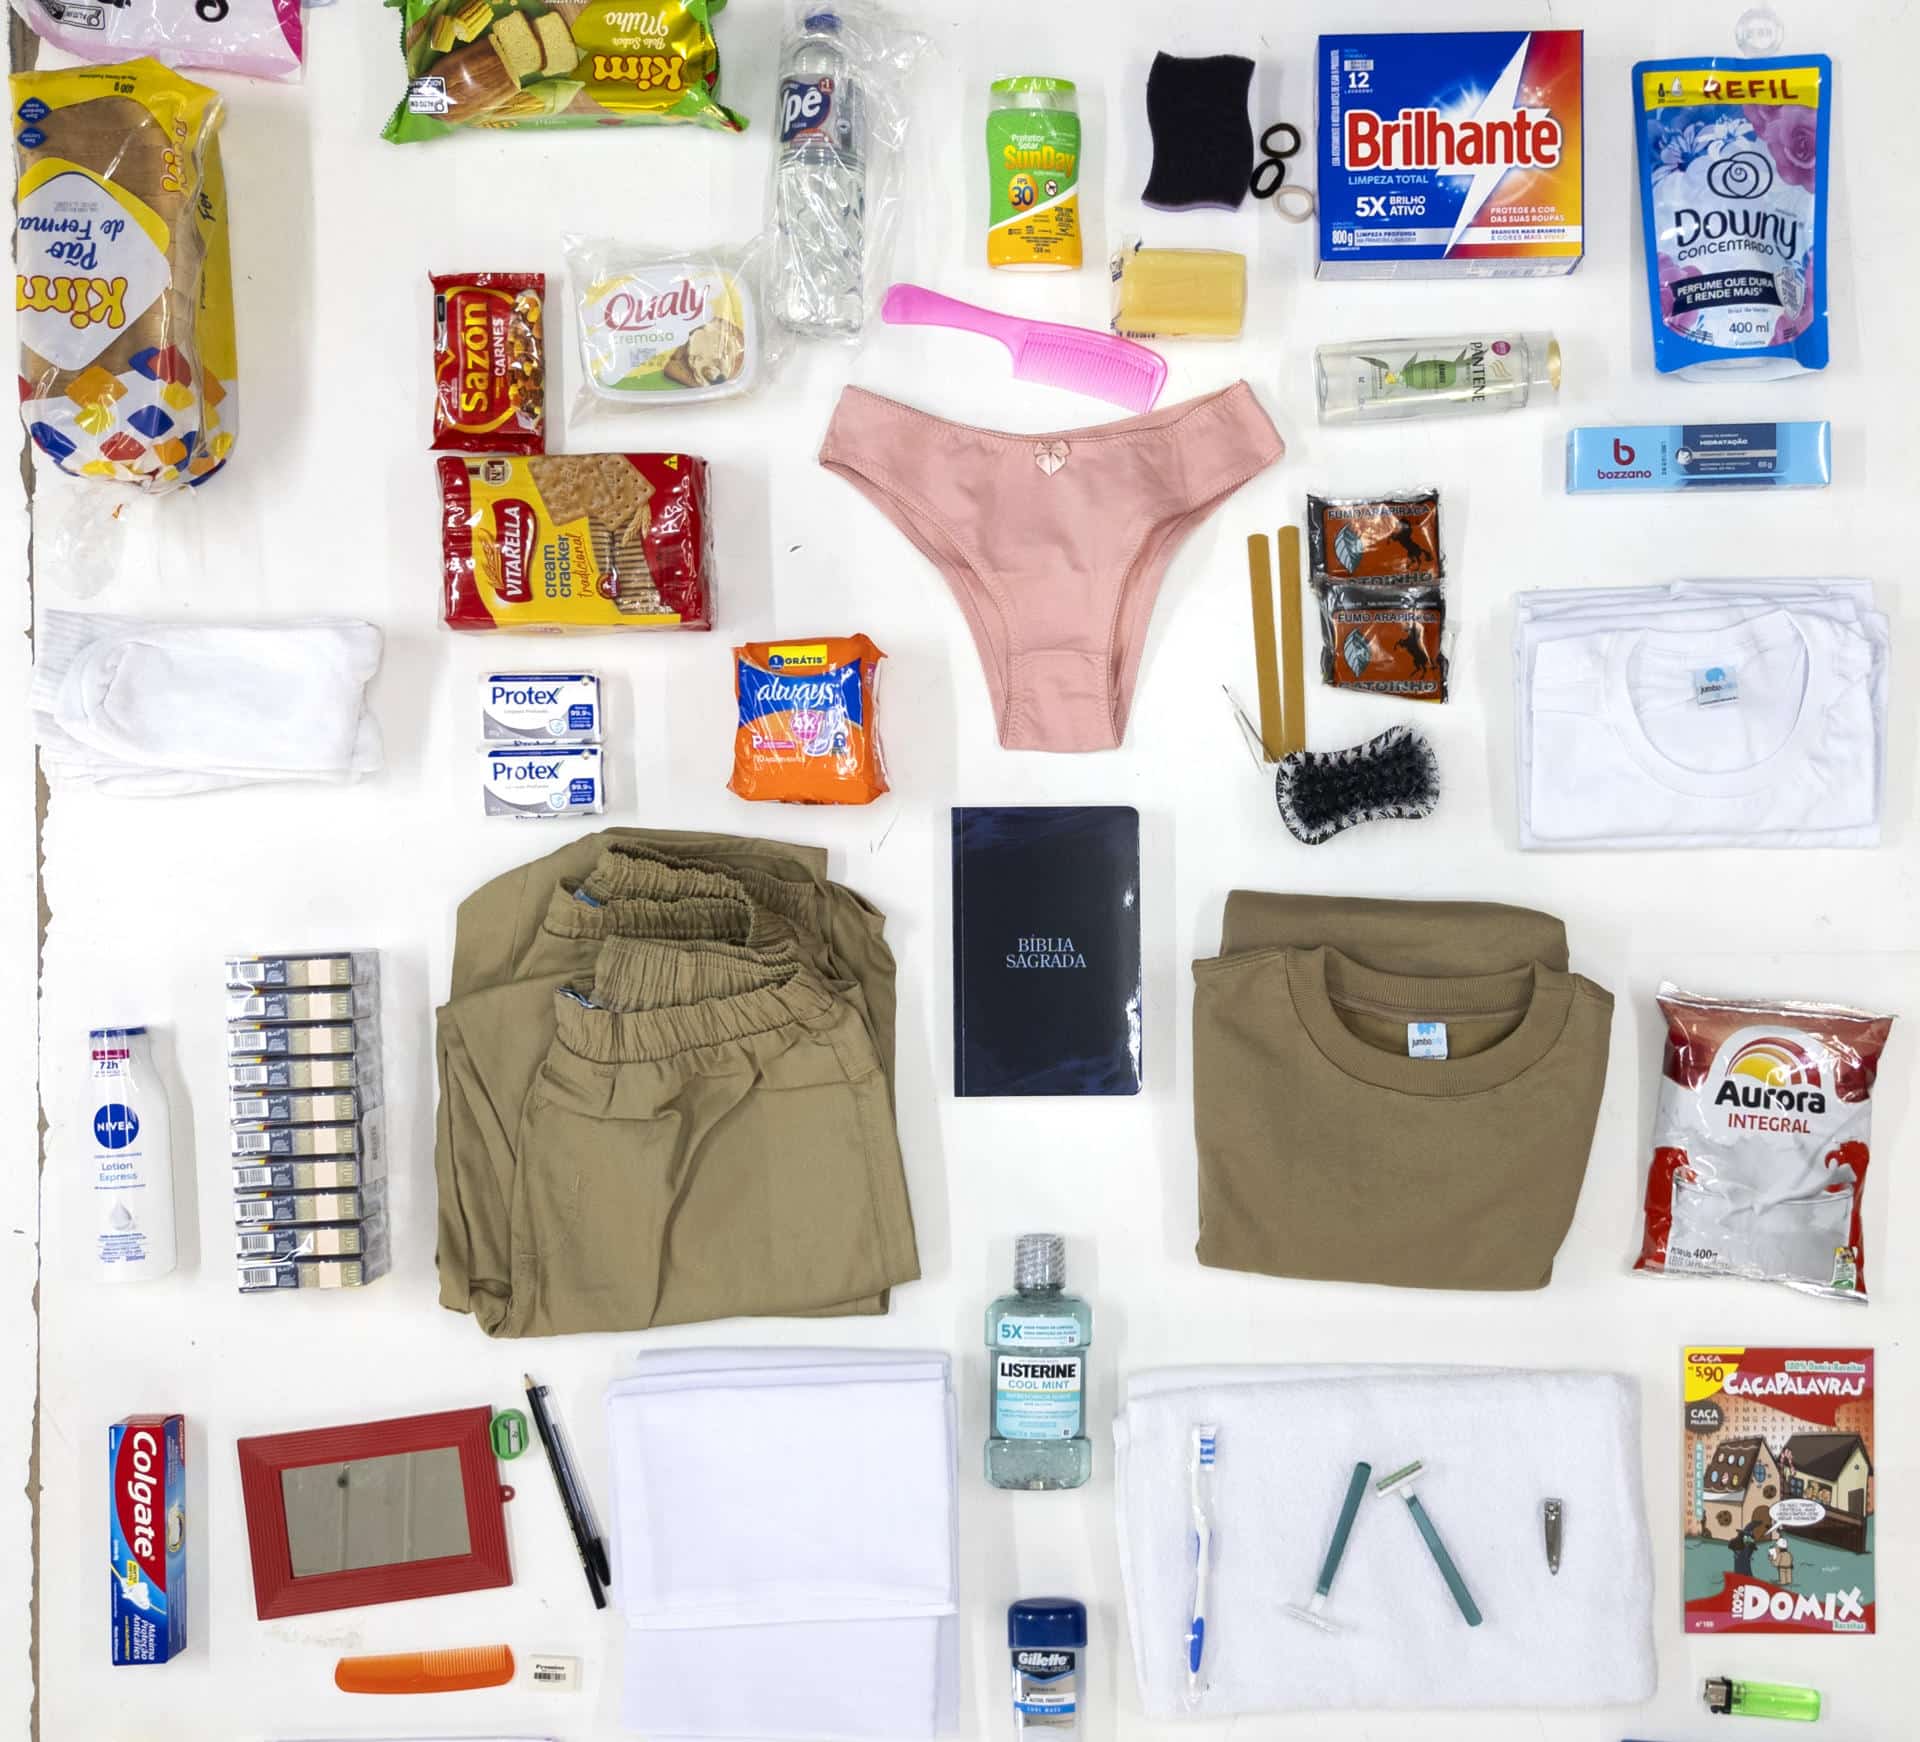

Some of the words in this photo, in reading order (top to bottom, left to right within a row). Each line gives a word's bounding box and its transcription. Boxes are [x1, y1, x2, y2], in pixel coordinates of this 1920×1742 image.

[604, 11, 669, 36] Milho
[592, 54, 684, 91] Kim
[1348, 72, 1370, 89] 12
[1703, 79, 1799, 100] REFIL
[783, 87, 822, 133] pê
[1346, 109, 1560, 168] Brilhante
[1003, 144, 1076, 178] SunDay
[1348, 175, 1394, 185] LIMPEZA
[1395, 174, 1429, 184] TOTAL
[1011, 186, 1034, 206] 30
[1355, 196, 1387, 217] 5X
[1389, 195, 1426, 205] BRILHO
[1389, 205, 1426, 216] ATIVO
[1490, 206, 1529, 214] PROTEGE
[1537, 206, 1556, 214] COR
[1531, 214, 1565, 222] ROUPAS
[19, 217, 92, 239] Forma
[100, 219, 125, 241] de
[1674, 208, 1799, 260] Downy
[46, 241, 98, 270] Pão
[1677, 240, 1774, 261] CONCENTRADO
[1677, 279, 1723, 297] PERFUME
[1724, 277, 1747, 287] QUE
[1748, 277, 1774, 288] DURA
[1686, 295, 1693, 304] E
[1694, 289, 1731, 301] RENDE
[17, 276, 128, 329] Kim
[603, 279, 711, 332] Qualy
[1728, 322, 1753, 334] 400
[1755, 322, 1770, 333] ml
[491, 318, 506, 377] CARNES
[614, 332, 675, 346] remoso
[460, 302, 491, 413] Sazón
[1470, 341, 1486, 403] PANTENE
[1597, 468, 1652, 480] bozzano
[501, 506, 524, 597] VITARELLA
[544, 543, 556, 598] cream
[558, 534, 572, 598] cracker
[576, 532, 594, 598] tradicional
[1338, 613, 1370, 624] FUMO
[785, 657, 823, 665] GRÁTIS
[492, 686, 560, 705] Protex
[757, 678, 835, 708] always
[492, 761, 560, 782] Protex
[1017, 934, 1075, 952] BÍBLIA
[1006, 954, 1088, 969] SAGRADA
[1714, 1080, 1827, 1114] Aurora
[96, 1121, 135, 1132] NIVEA
[1727, 1113, 1811, 1134] INTEGRAL
[99, 1171, 138, 1183] Express
[101, 1162, 133, 1172] Lotion
[1001, 1324, 1023, 1339] 5X
[1691, 1354, 1722, 1363] CAÇA
[1000, 1362, 1077, 1379] LISTERINE
[1007, 1380, 1040, 1389] COOL
[1042, 1379, 1070, 1389] MINT
[1690, 1409, 1719, 1421] CAÇA
[127, 1430, 158, 1558] Colgate
[1731, 1585, 1745, 1618] 100%
[1743, 1584, 1865, 1621] DOMIX
[1018, 1652, 1068, 1666] Gillette
